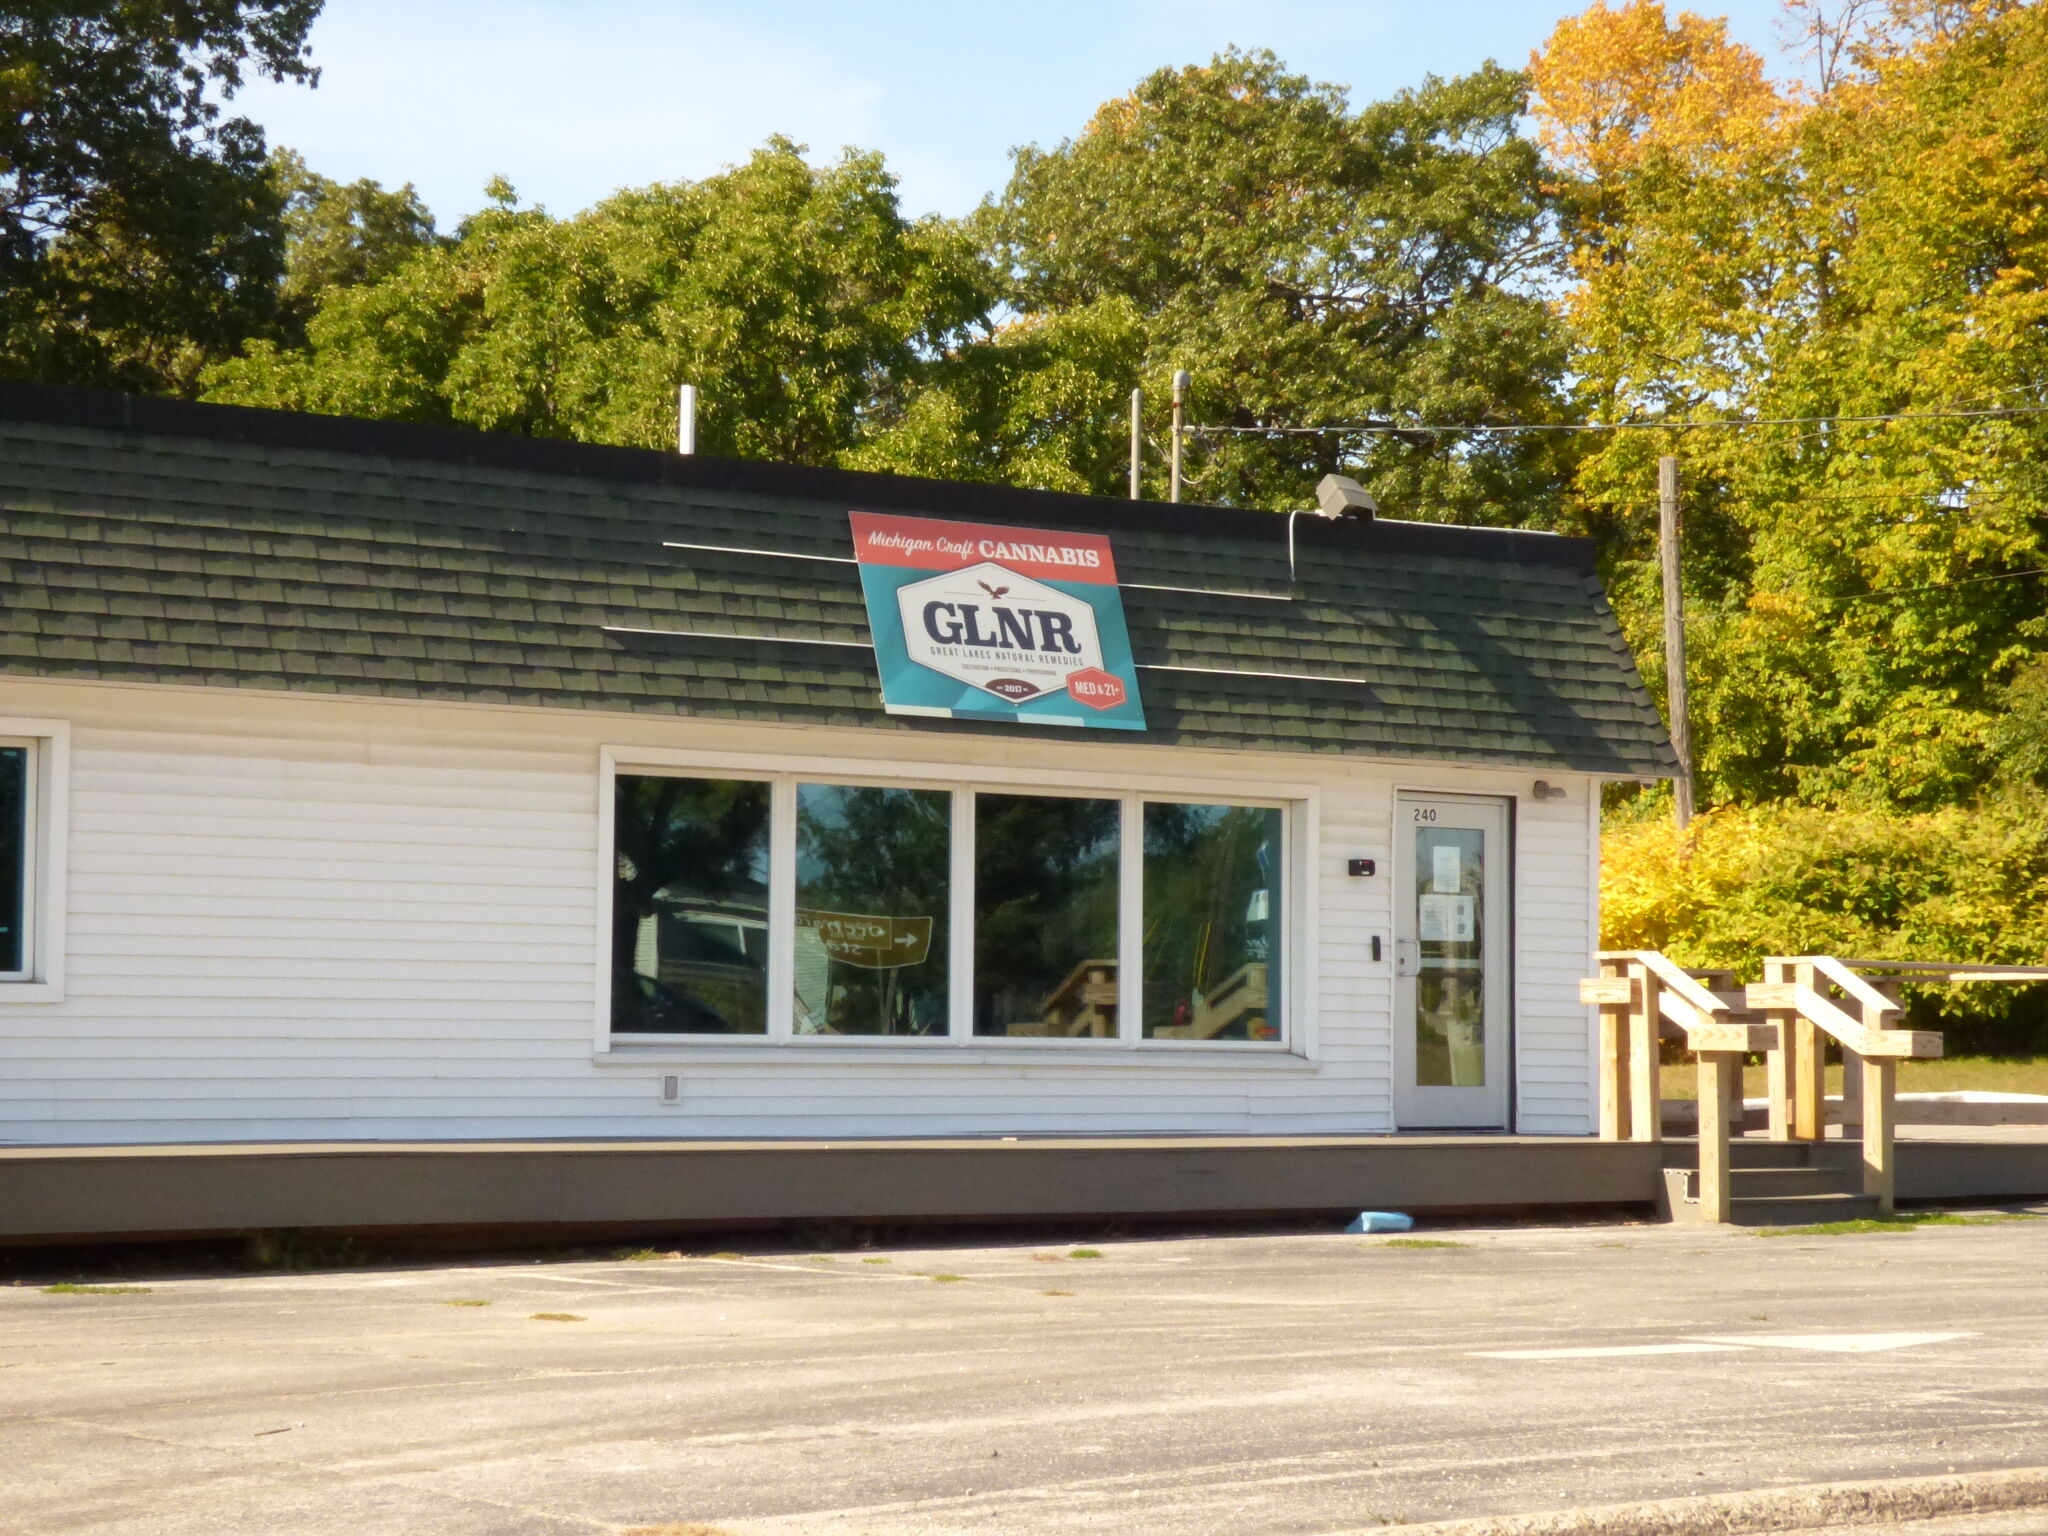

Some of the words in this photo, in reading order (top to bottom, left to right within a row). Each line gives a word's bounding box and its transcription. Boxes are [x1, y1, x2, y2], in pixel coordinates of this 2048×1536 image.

[867, 531, 934, 556] Michigan
[936, 536, 975, 561] Craft
[979, 539, 1101, 568] CANNABIS
[922, 600, 1082, 655] GLNR
[930, 646, 959, 657] GREAT
[962, 648, 992, 660] LAKES
[995, 650, 1035, 664] NATURAL
[1039, 653, 1084, 667] REMEDIES
[1004, 684, 1022, 693] 2017
[1074, 681, 1097, 695] MED
[1104, 683, 1120, 697] 21+
[1414, 808, 1437, 822] 240
